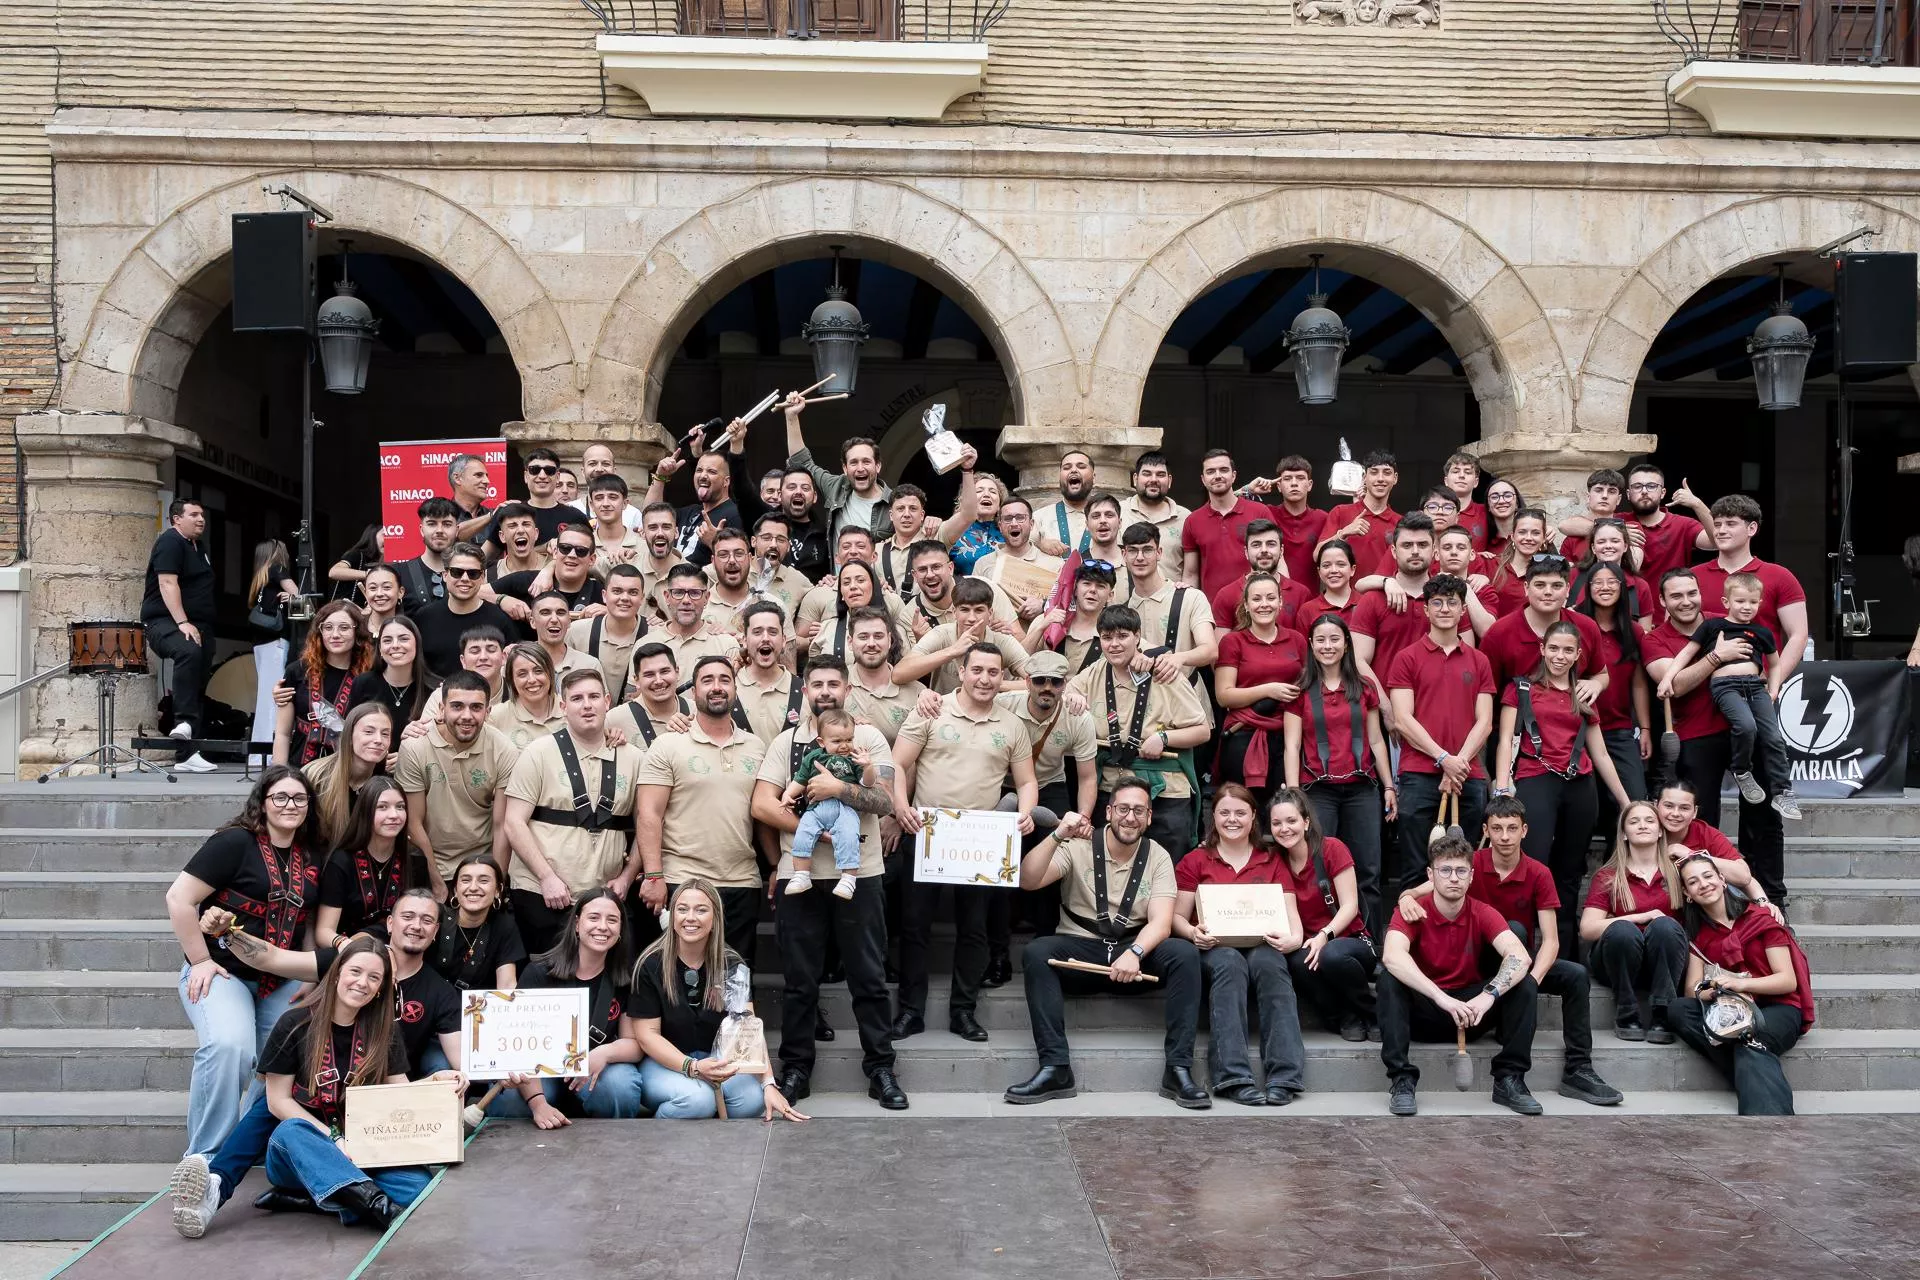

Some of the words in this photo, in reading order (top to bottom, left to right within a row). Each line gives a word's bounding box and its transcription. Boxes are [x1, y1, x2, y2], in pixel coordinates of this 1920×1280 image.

[879, 383, 926, 423] ILUSTRE
[421, 452, 463, 465] HINAC
[390, 488, 434, 501] HINACO
[960, 822, 998, 830] PREMIO
[941, 847, 996, 863] 1000€
[516, 1003, 561, 1013] PREMIO
[497, 1035, 553, 1052] 300€
[363, 1124, 399, 1135] VIÑAS
[413, 1122, 442, 1133] JARO
